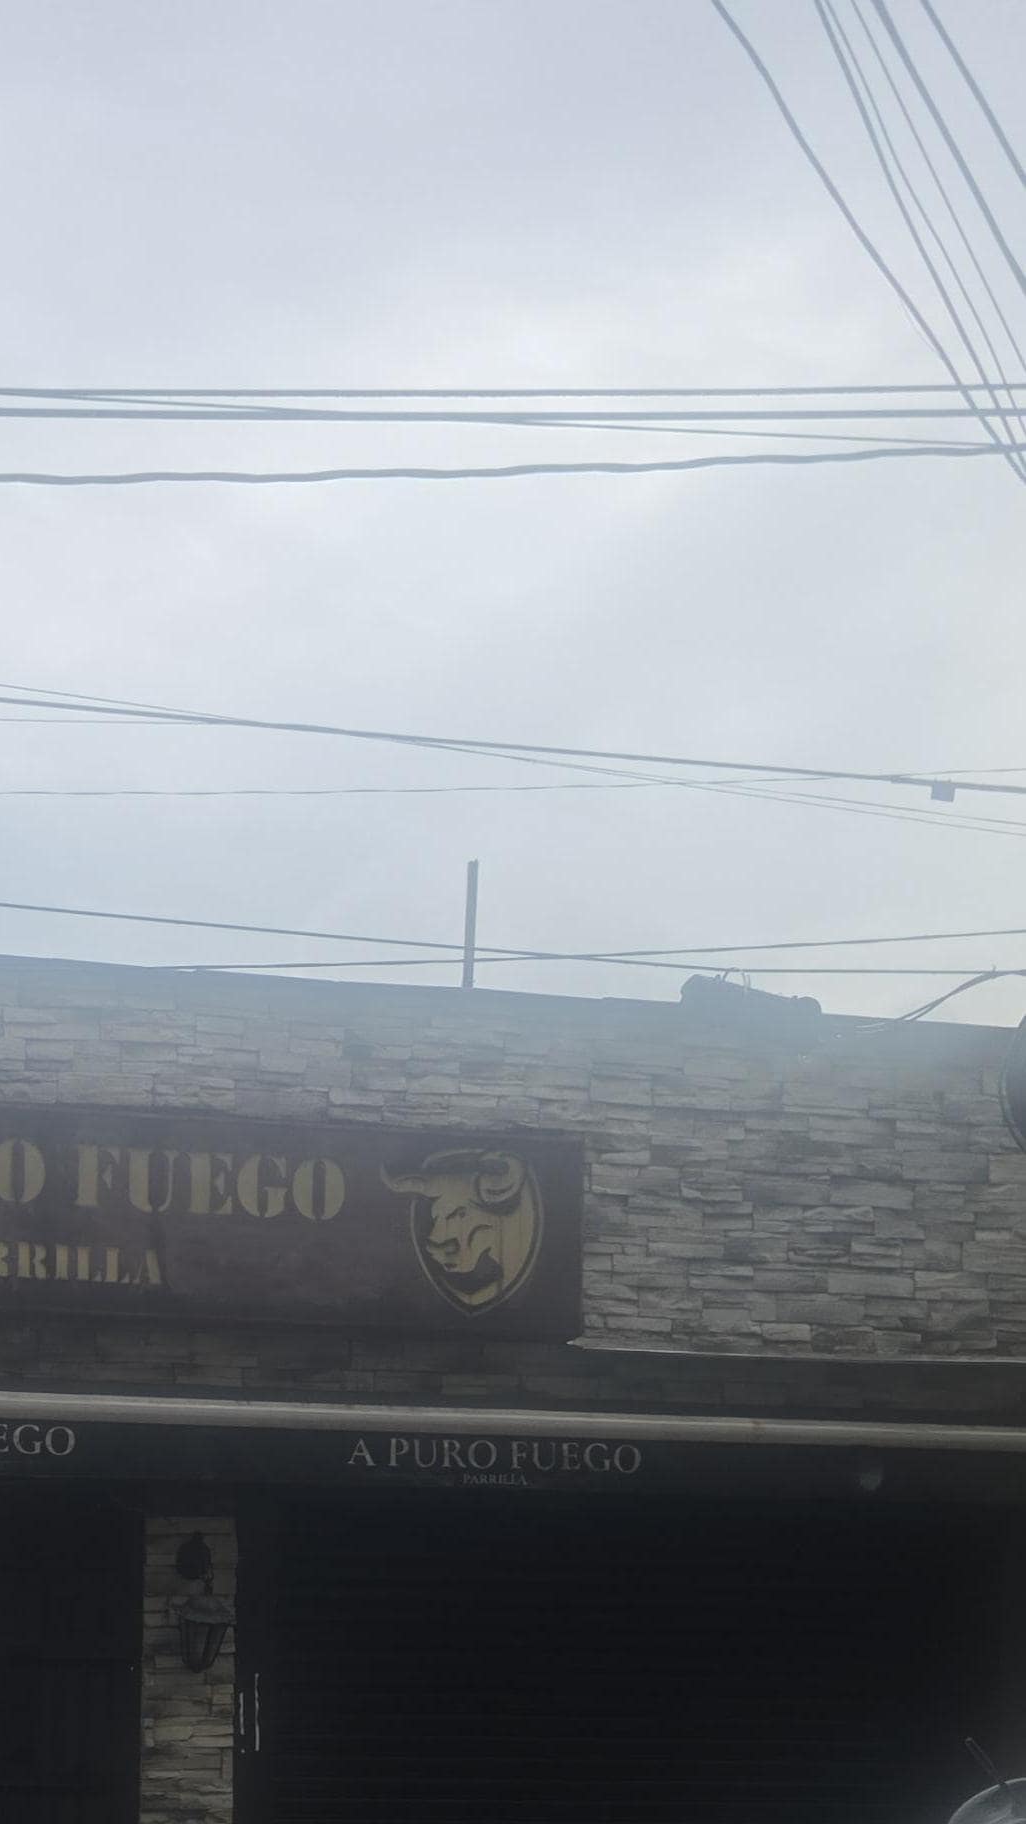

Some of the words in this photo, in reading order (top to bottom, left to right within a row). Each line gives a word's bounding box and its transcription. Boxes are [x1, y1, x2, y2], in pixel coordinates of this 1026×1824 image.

[75, 1142, 347, 1221] FUEGO
[347, 1437, 376, 1466] A
[388, 1437, 497, 1470] PURO
[509, 1441, 643, 1474] FUEGO
[462, 1473, 528, 1486] PARRILLA
